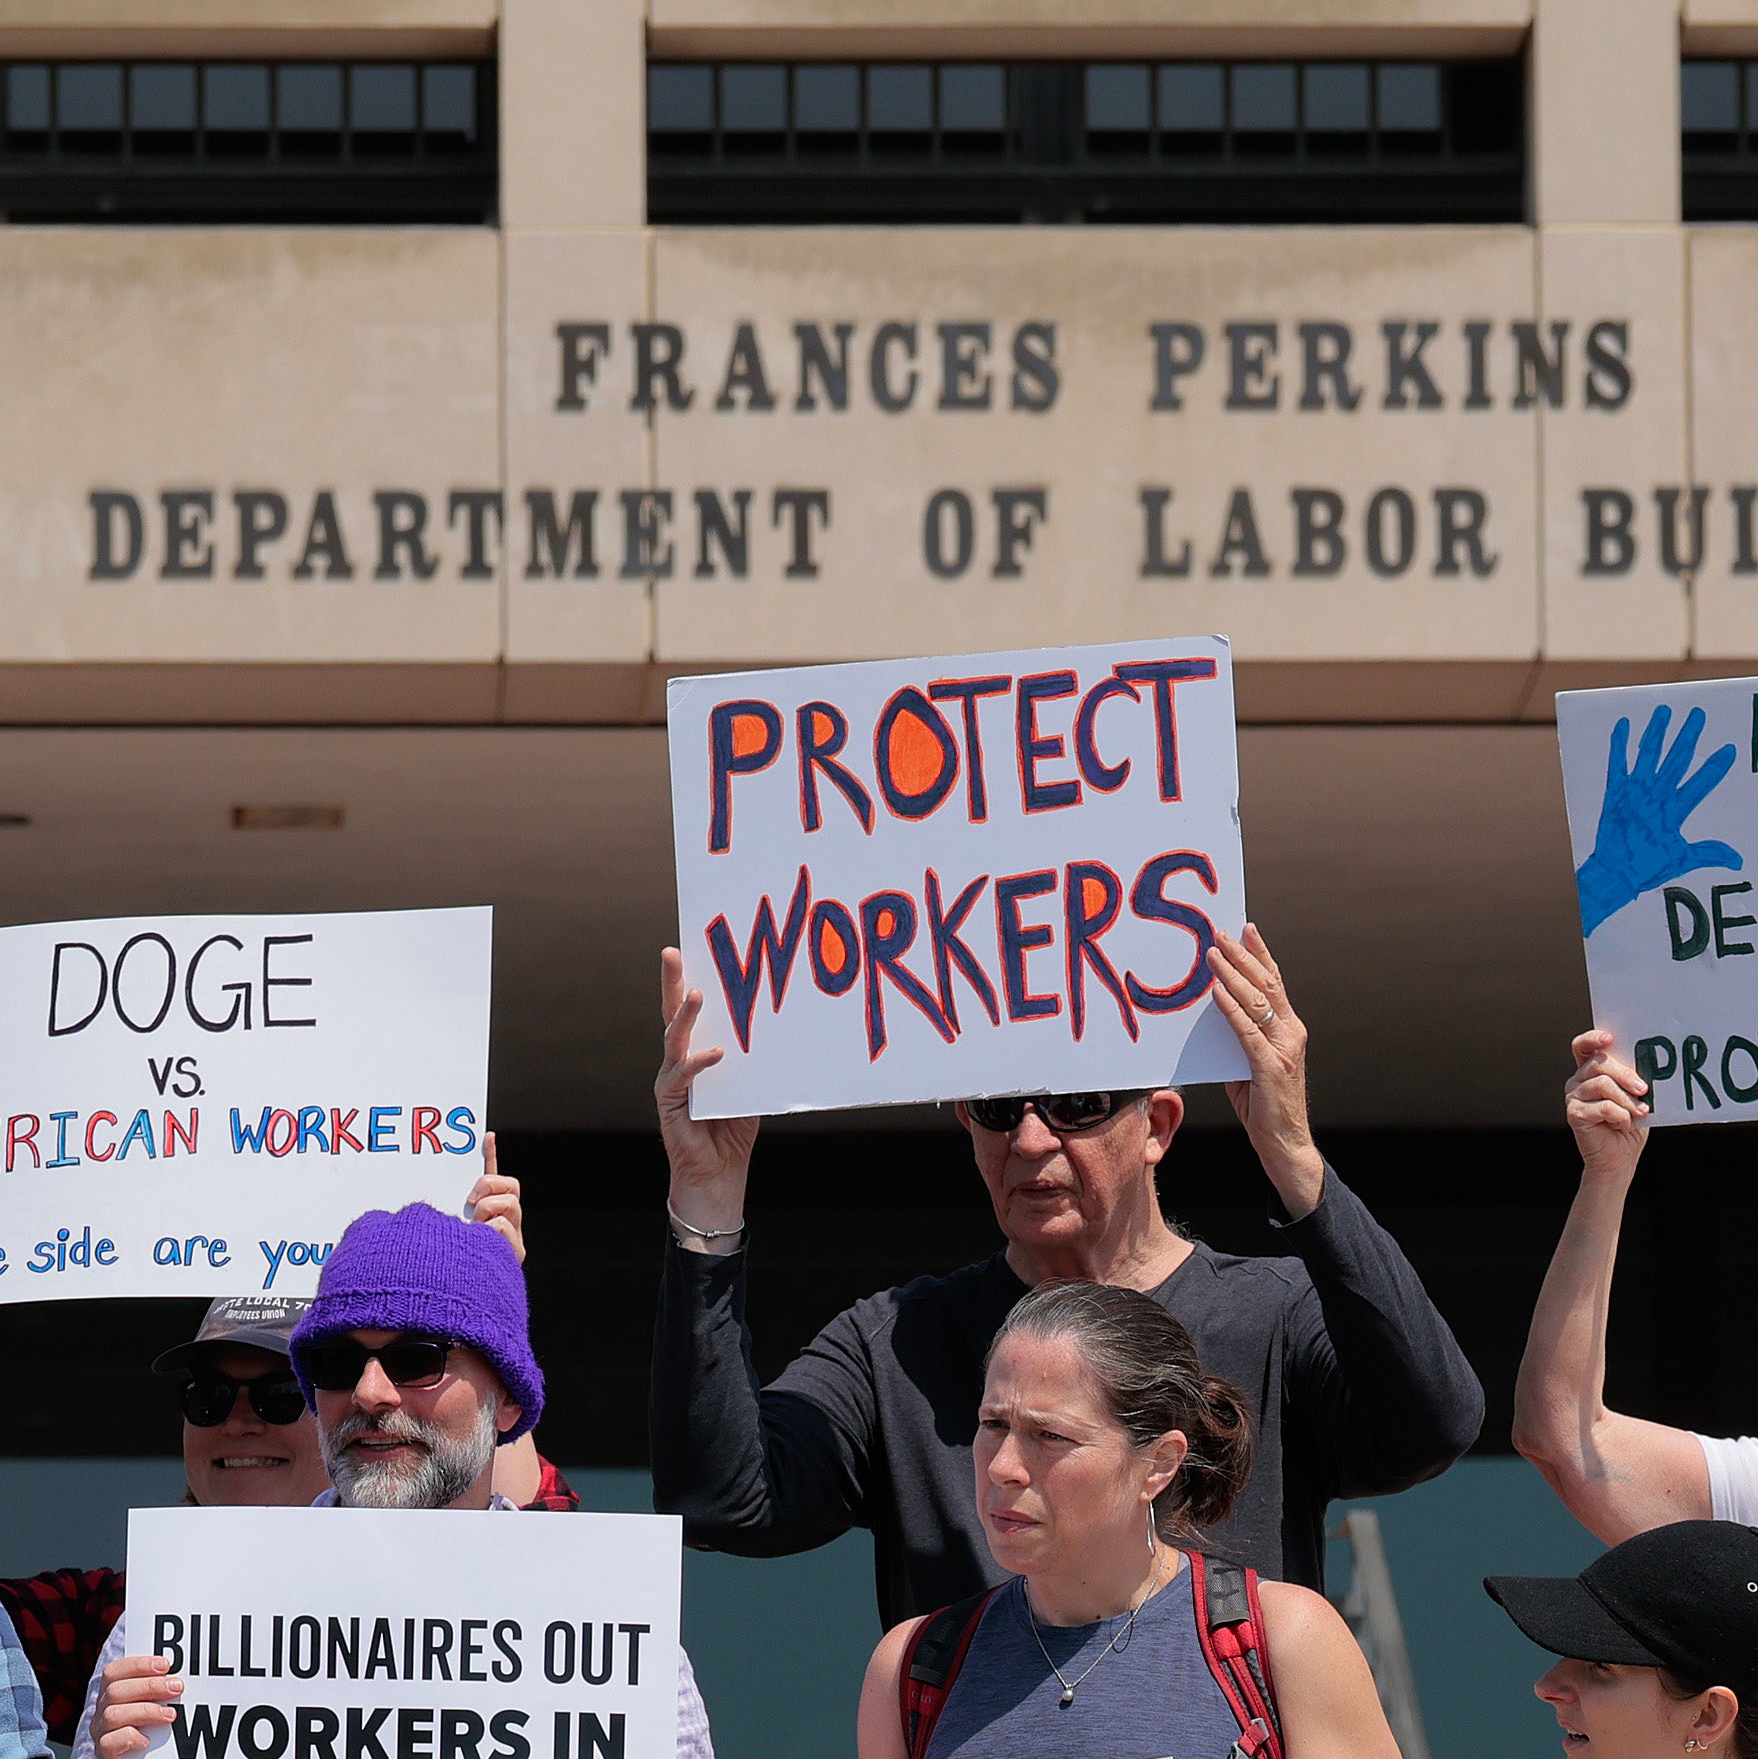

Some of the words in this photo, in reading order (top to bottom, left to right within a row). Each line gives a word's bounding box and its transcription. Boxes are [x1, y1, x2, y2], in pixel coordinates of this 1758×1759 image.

[555, 320, 1062, 414] FRANCES
[1147, 320, 1635, 413] PERKINS
[85, 488, 833, 582] DEPARTMENT
[921, 487, 1048, 578] OF
[1138, 485, 1499, 580] LABOR
[707, 657, 1218, 854] PROTECT
[48, 932, 316, 1036] DOGE
[705, 849, 1219, 1064] WORKERS
[231, 1106, 477, 1158] WORKERS
[27, 1226, 119, 1274] side
[153, 1234, 231, 1268] are
[258, 1239, 333, 1290] you
[246, 1297, 290, 1309] LOCAL
[262, 1308, 286, 1320] UNION
[153, 1614, 524, 1684] BILLIONAIRES
[543, 1620, 651, 1687] OUT
